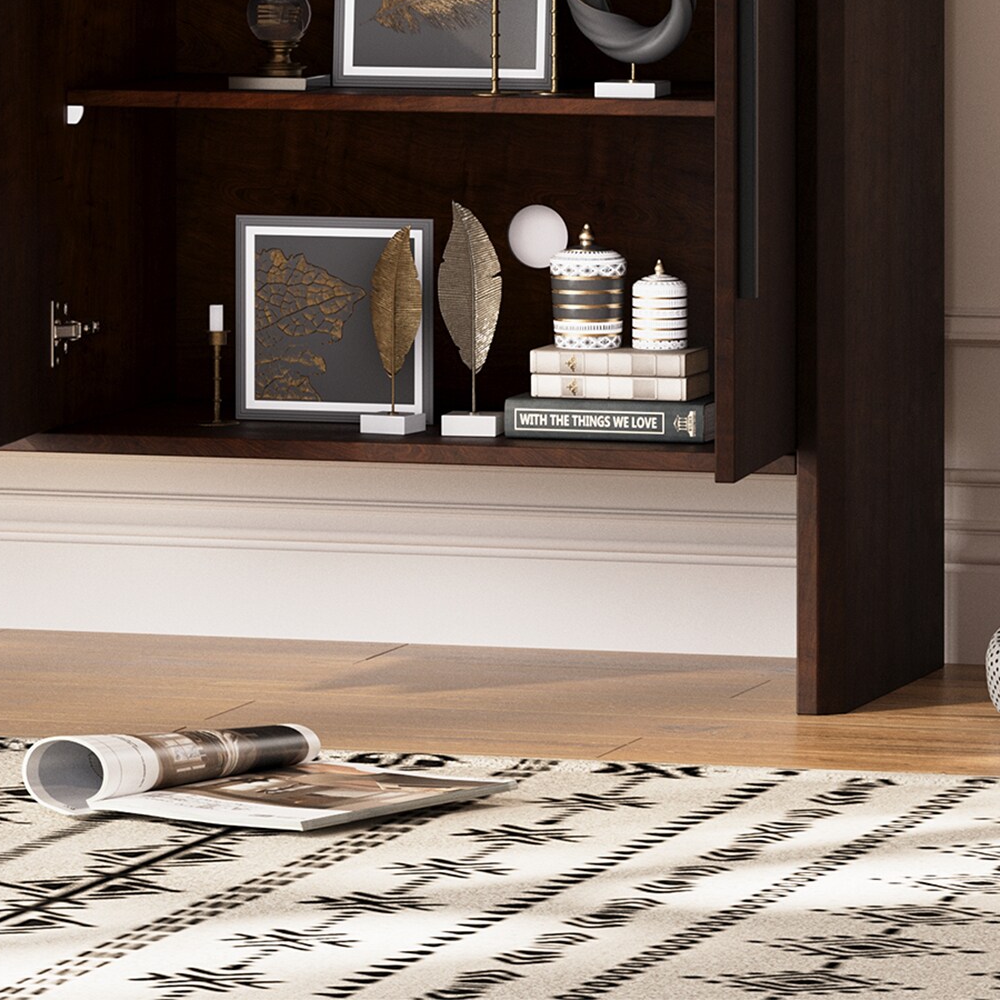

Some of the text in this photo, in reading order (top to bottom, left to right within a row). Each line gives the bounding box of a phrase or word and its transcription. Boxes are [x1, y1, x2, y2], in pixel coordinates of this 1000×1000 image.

[519, 412, 658, 430] WITH THE THINGS WE LOVE
